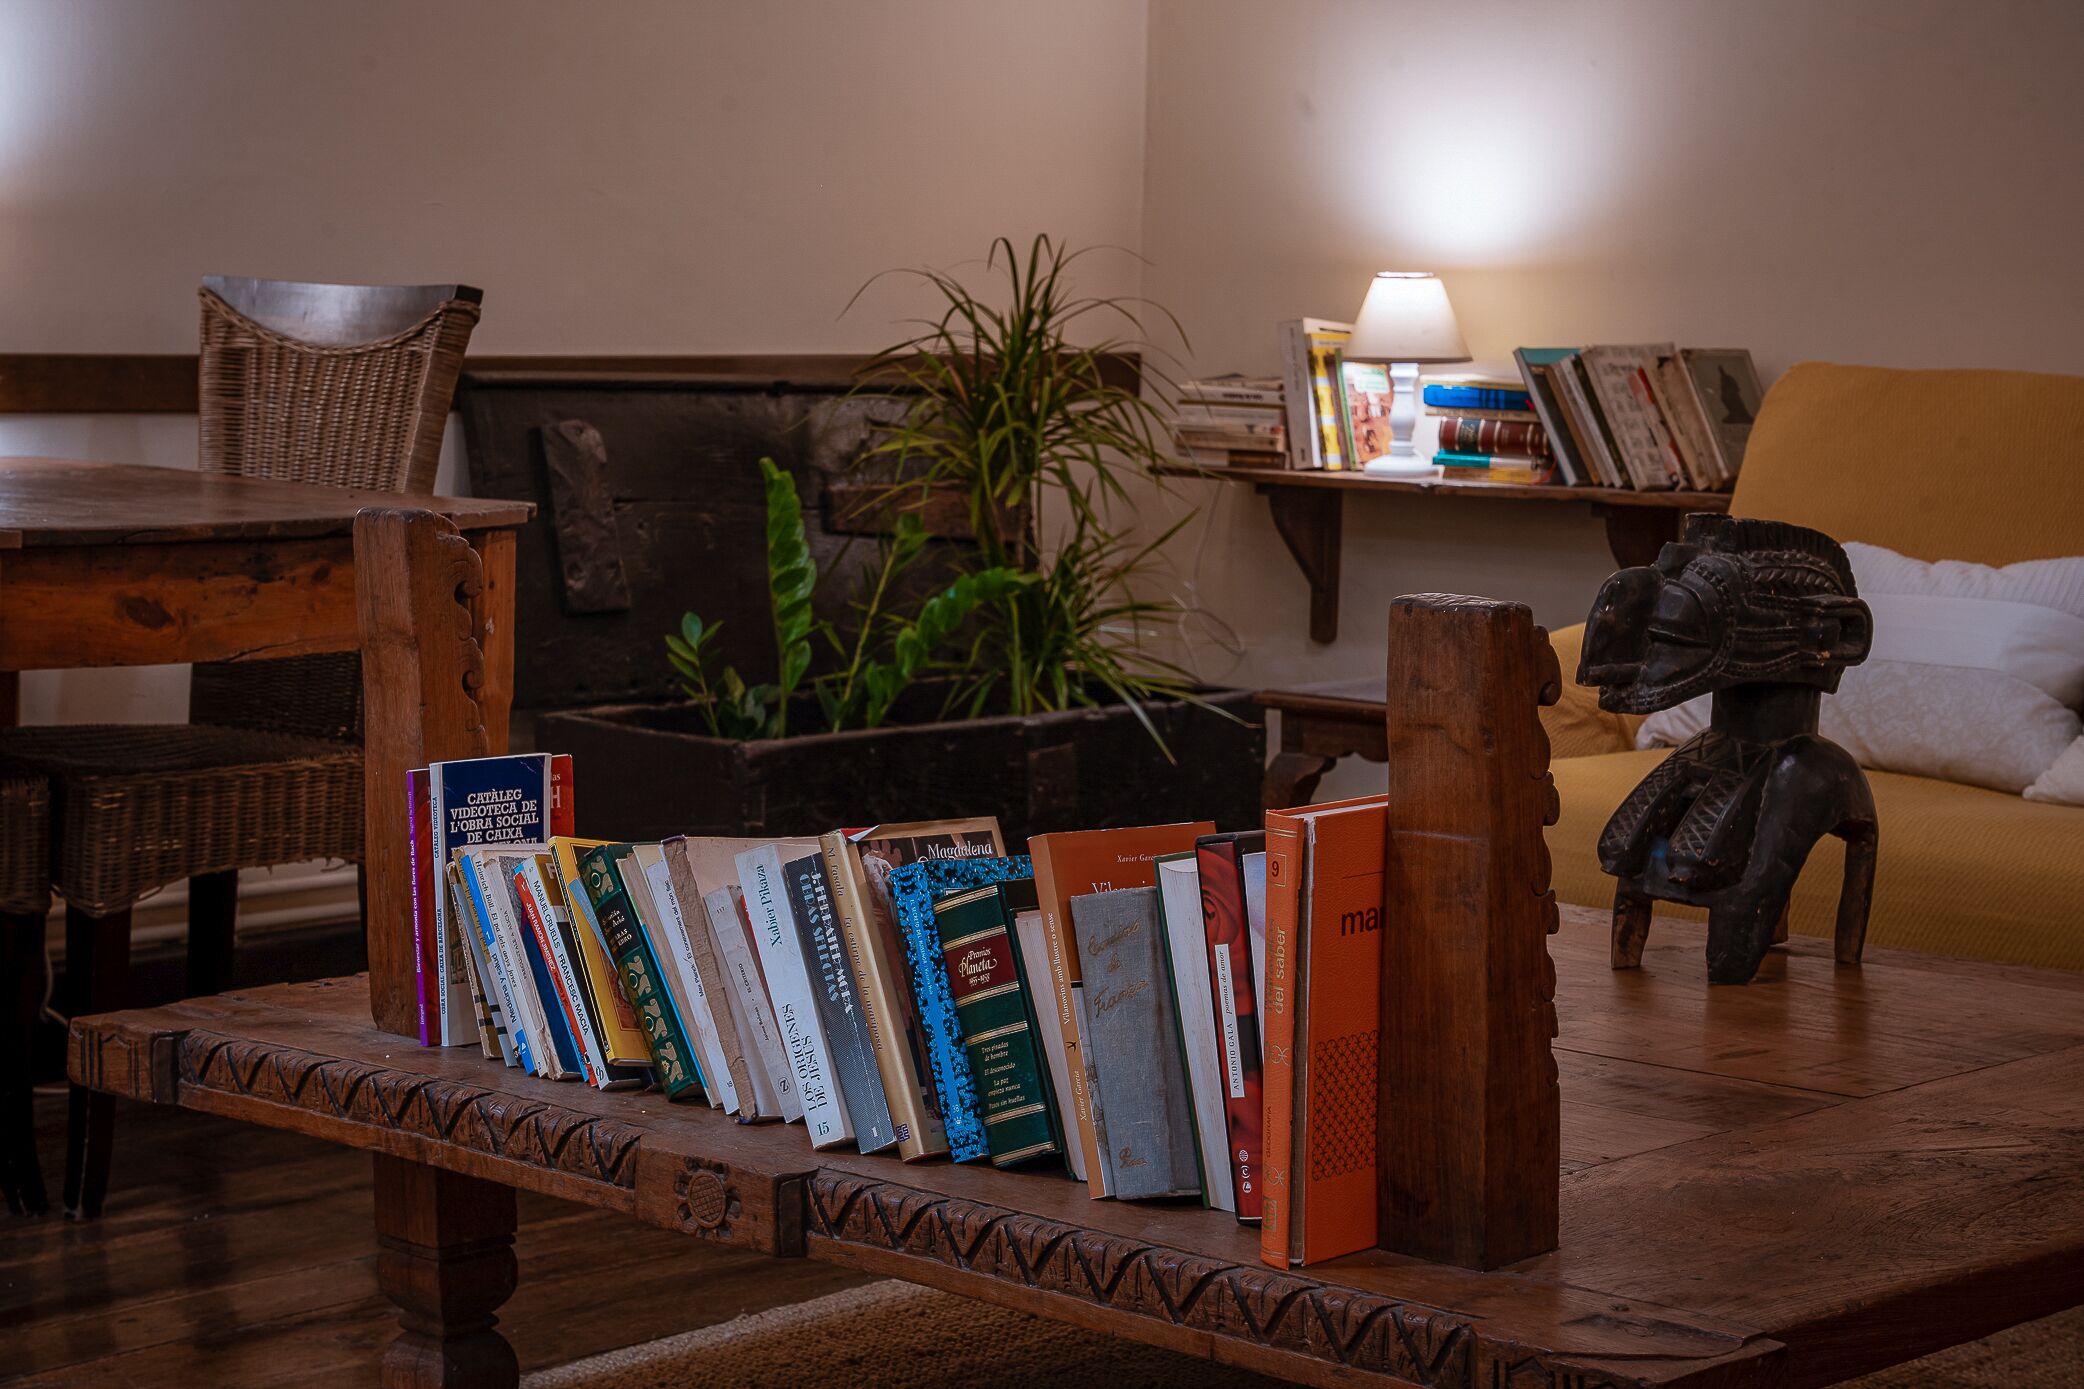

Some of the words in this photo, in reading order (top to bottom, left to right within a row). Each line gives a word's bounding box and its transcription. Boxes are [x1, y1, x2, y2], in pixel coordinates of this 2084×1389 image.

[467, 788, 522, 805] CATÀLEG
[450, 804, 518, 820] VIDEOTECA
[521, 800, 537, 812] DE
[450, 818, 493, 834] L'OBRA
[496, 812, 539, 828] SOCIAL
[466, 832, 482, 844] DE
[485, 826, 524, 842] CAIXA
[928, 840, 994, 860] Magdalena
[1117, 854, 1138, 862] Xavier
[411, 858, 416, 867] de
[1271, 860, 1280, 878] 9
[476, 860, 488, 892] Heinrich
[756, 864, 772, 906] Pikaza
[492, 912, 498, 920] El
[526, 902, 536, 920] JUAN
[494, 922, 501, 933] pa
[766, 907, 782, 948] Xabier
[1048, 912, 1056, 932] sense
[800, 873, 820, 924] OBRAS
[813, 926, 840, 1002] SELECTAS
[438, 945, 443, 953] DE
[533, 880, 548, 916] MANUEL
[544, 914, 560, 949] CRUELLS
[558, 954, 578, 1002] FRANCESC
[574, 1003, 590, 1036] MACIÀ
[686, 952, 693, 960] El
[815, 885, 842, 964] FERRATER
[837, 968, 854, 1014] MORA
[826, 847, 836, 861] M.
[848, 932, 862, 968] estirpe
[858, 970, 866, 982] de
[862, 986, 870, 996] la
[866, 1000, 883, 1050] mariposa
[1276, 926, 1287, 980] saber
[492, 953, 502, 976] salud
[958, 958, 998, 978] Planeta
[1217, 950, 1226, 971] amor
[508, 970, 516, 988] joves
[690, 963, 698, 983] Planck
[738, 963, 750, 986] CRITERIO
[1056, 966, 1064, 983] amb
[1220, 973, 1227, 983] de
[746, 986, 752, 994] EL
[1224, 985, 1232, 1014] poemas
[502, 984, 516, 1023] Medicina
[1060, 984, 1070, 1025] Vilanovins
[1274, 988, 1284, 1014] del
[782, 1003, 808, 1080] ORIGENES
[1228, 1024, 1236, 1047] GALA
[802, 1035, 821, 1081] JESUS
[990, 1050, 1008, 1060] hombre
[984, 1068, 989, 1076] El
[1230, 1050, 1240, 1090] ANTONIO
[803, 1081, 817, 1112] LOS
[814, 1085, 828, 1108] DE
[817, 1120, 830, 1136] 15
